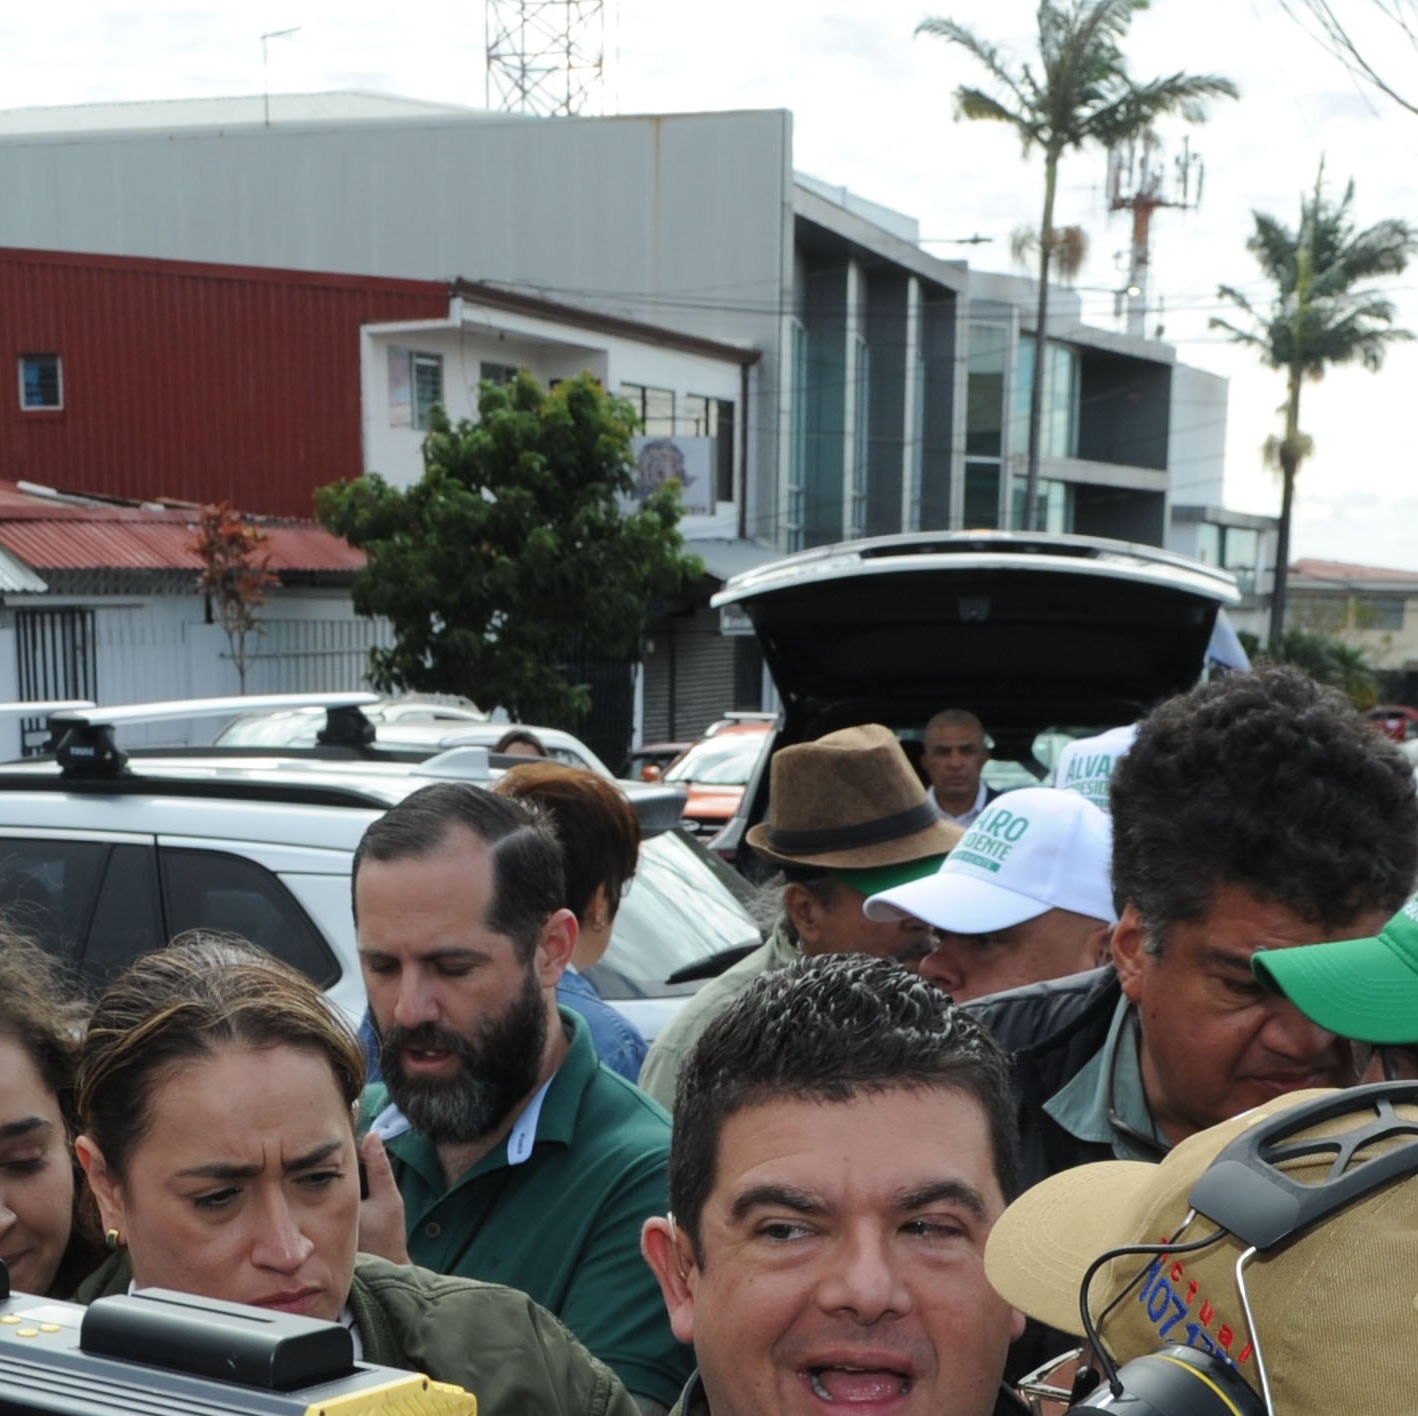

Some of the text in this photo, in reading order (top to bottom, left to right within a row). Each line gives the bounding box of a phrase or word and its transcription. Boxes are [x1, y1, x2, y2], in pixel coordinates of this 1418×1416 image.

[1065, 753, 1112, 784] ÁLVA
[972, 807, 1029, 842] ARO
[964, 830, 1013, 862] DENTE
